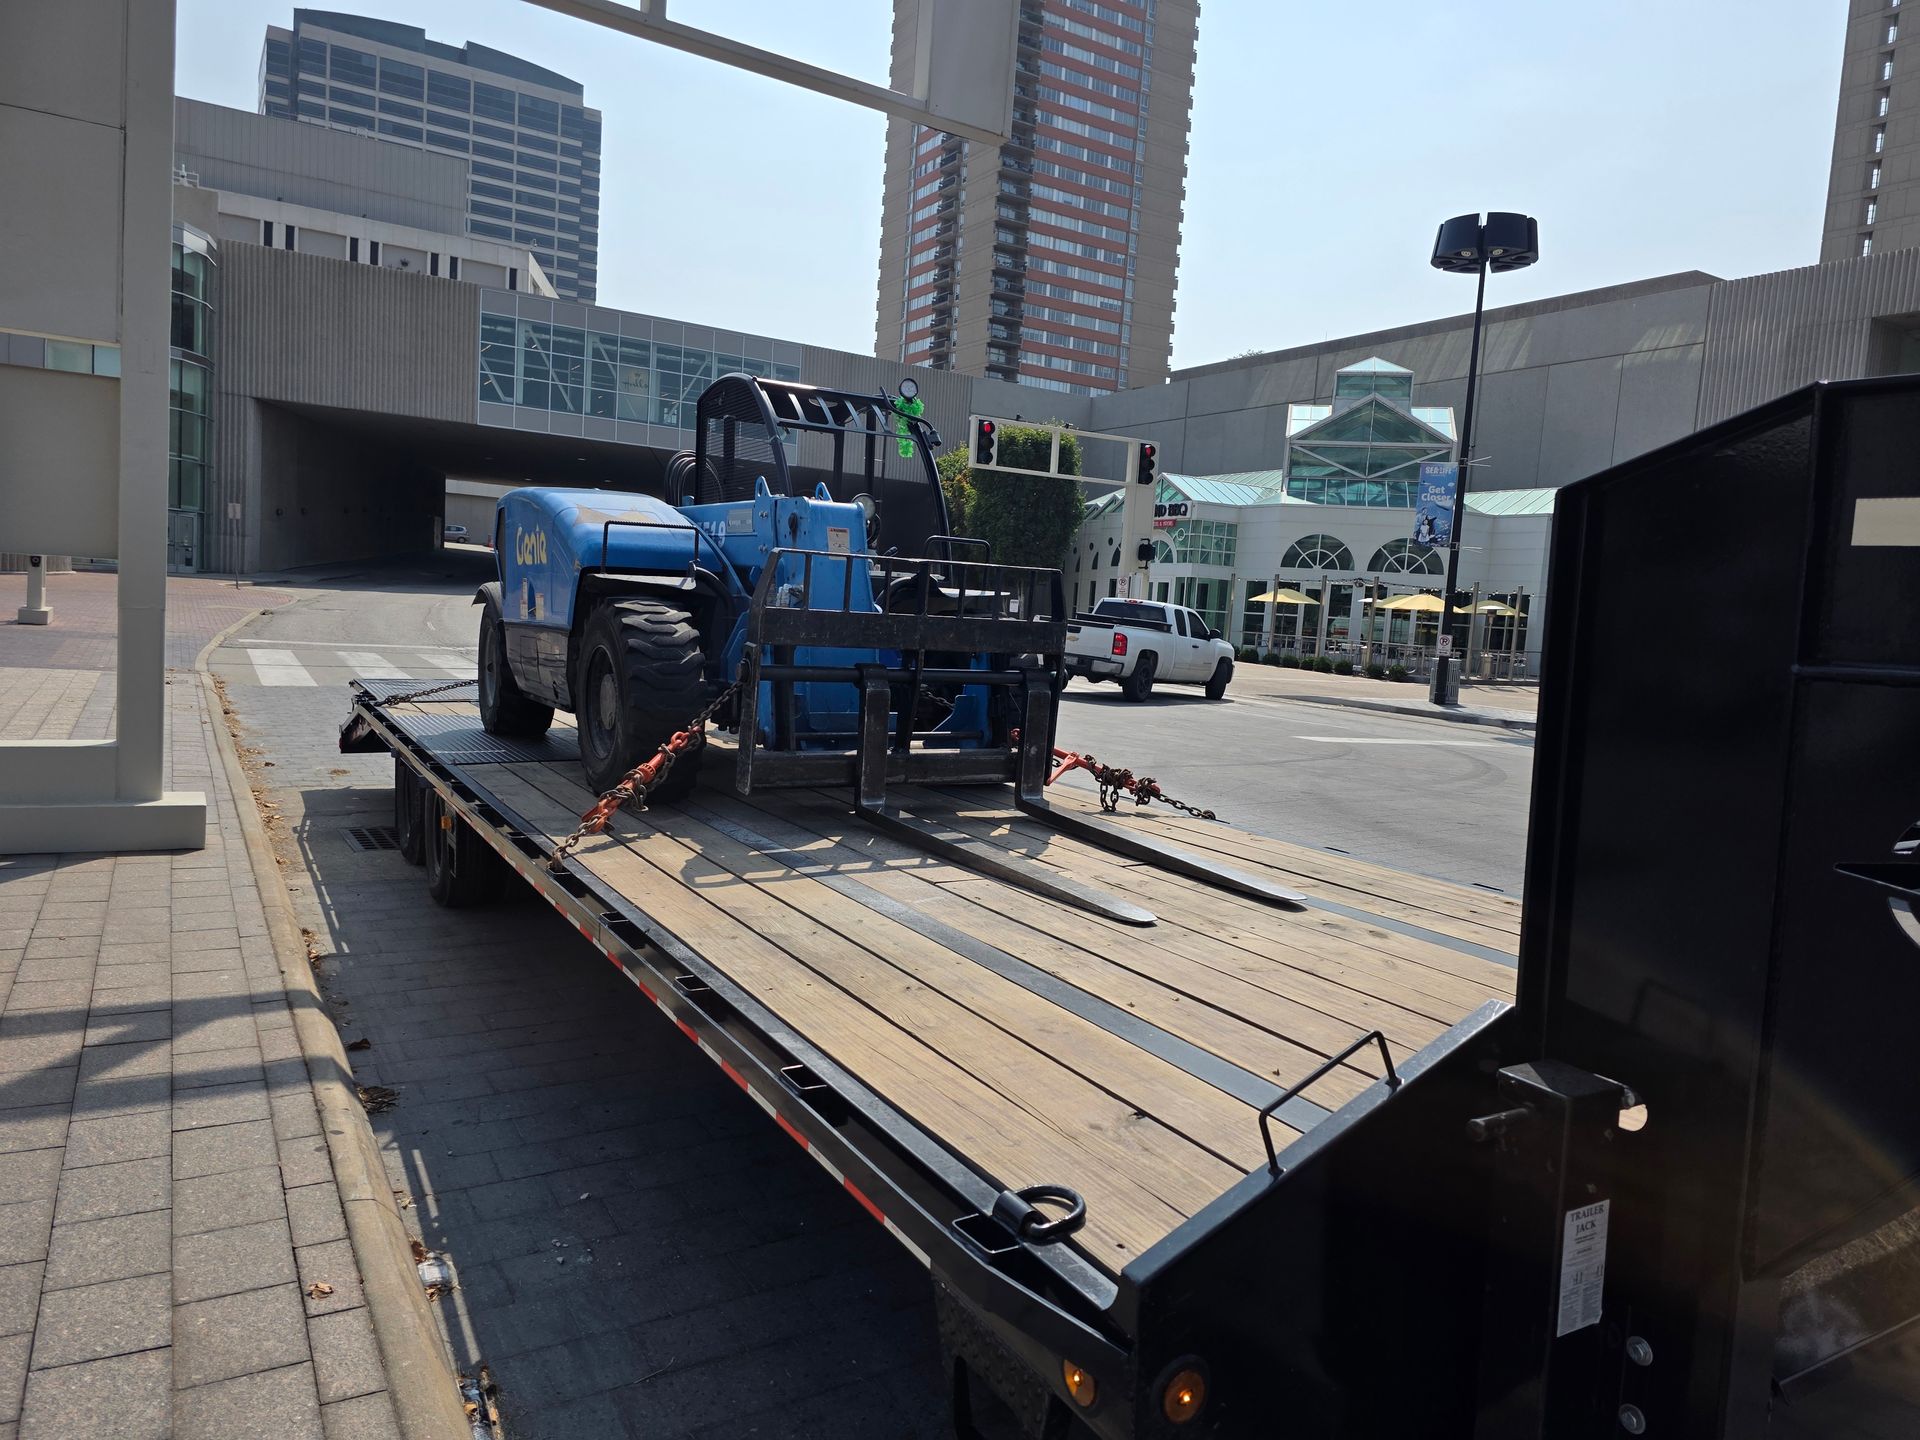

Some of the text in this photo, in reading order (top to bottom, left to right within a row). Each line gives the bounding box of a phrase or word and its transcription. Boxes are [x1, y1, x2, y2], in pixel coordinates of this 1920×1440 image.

[1421, 493, 1451, 503] Closer
[1428, 485, 1446, 495] Get
[1168, 502, 1189, 517] BBQ
[516, 523, 548, 566] Genie
[1570, 1203, 1605, 1222] TRAILER
[1575, 1219, 1597, 1237] JACK
